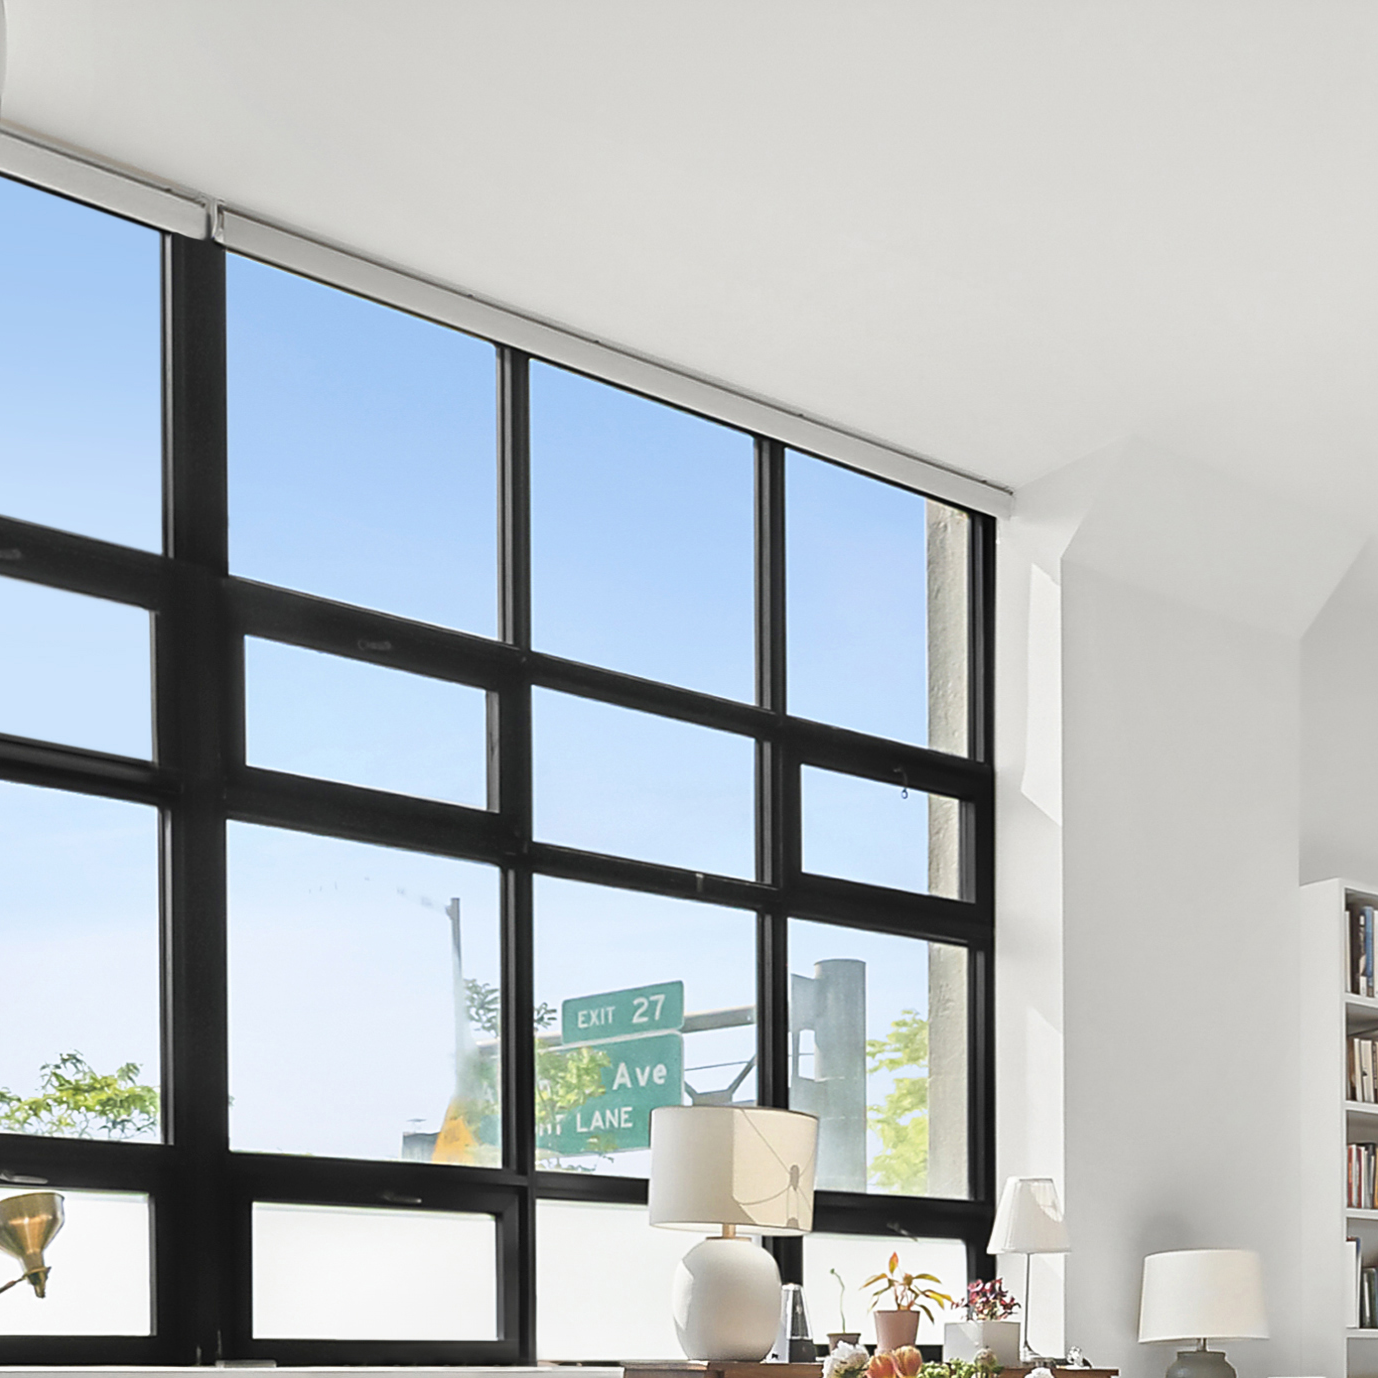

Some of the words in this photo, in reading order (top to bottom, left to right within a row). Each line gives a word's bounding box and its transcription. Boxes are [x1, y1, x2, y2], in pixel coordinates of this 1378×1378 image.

[577, 1006, 616, 1029] EXIT
[631, 994, 666, 1024] 27
[612, 1062, 667, 1090] Ave
[576, 1106, 634, 1133] LANE
